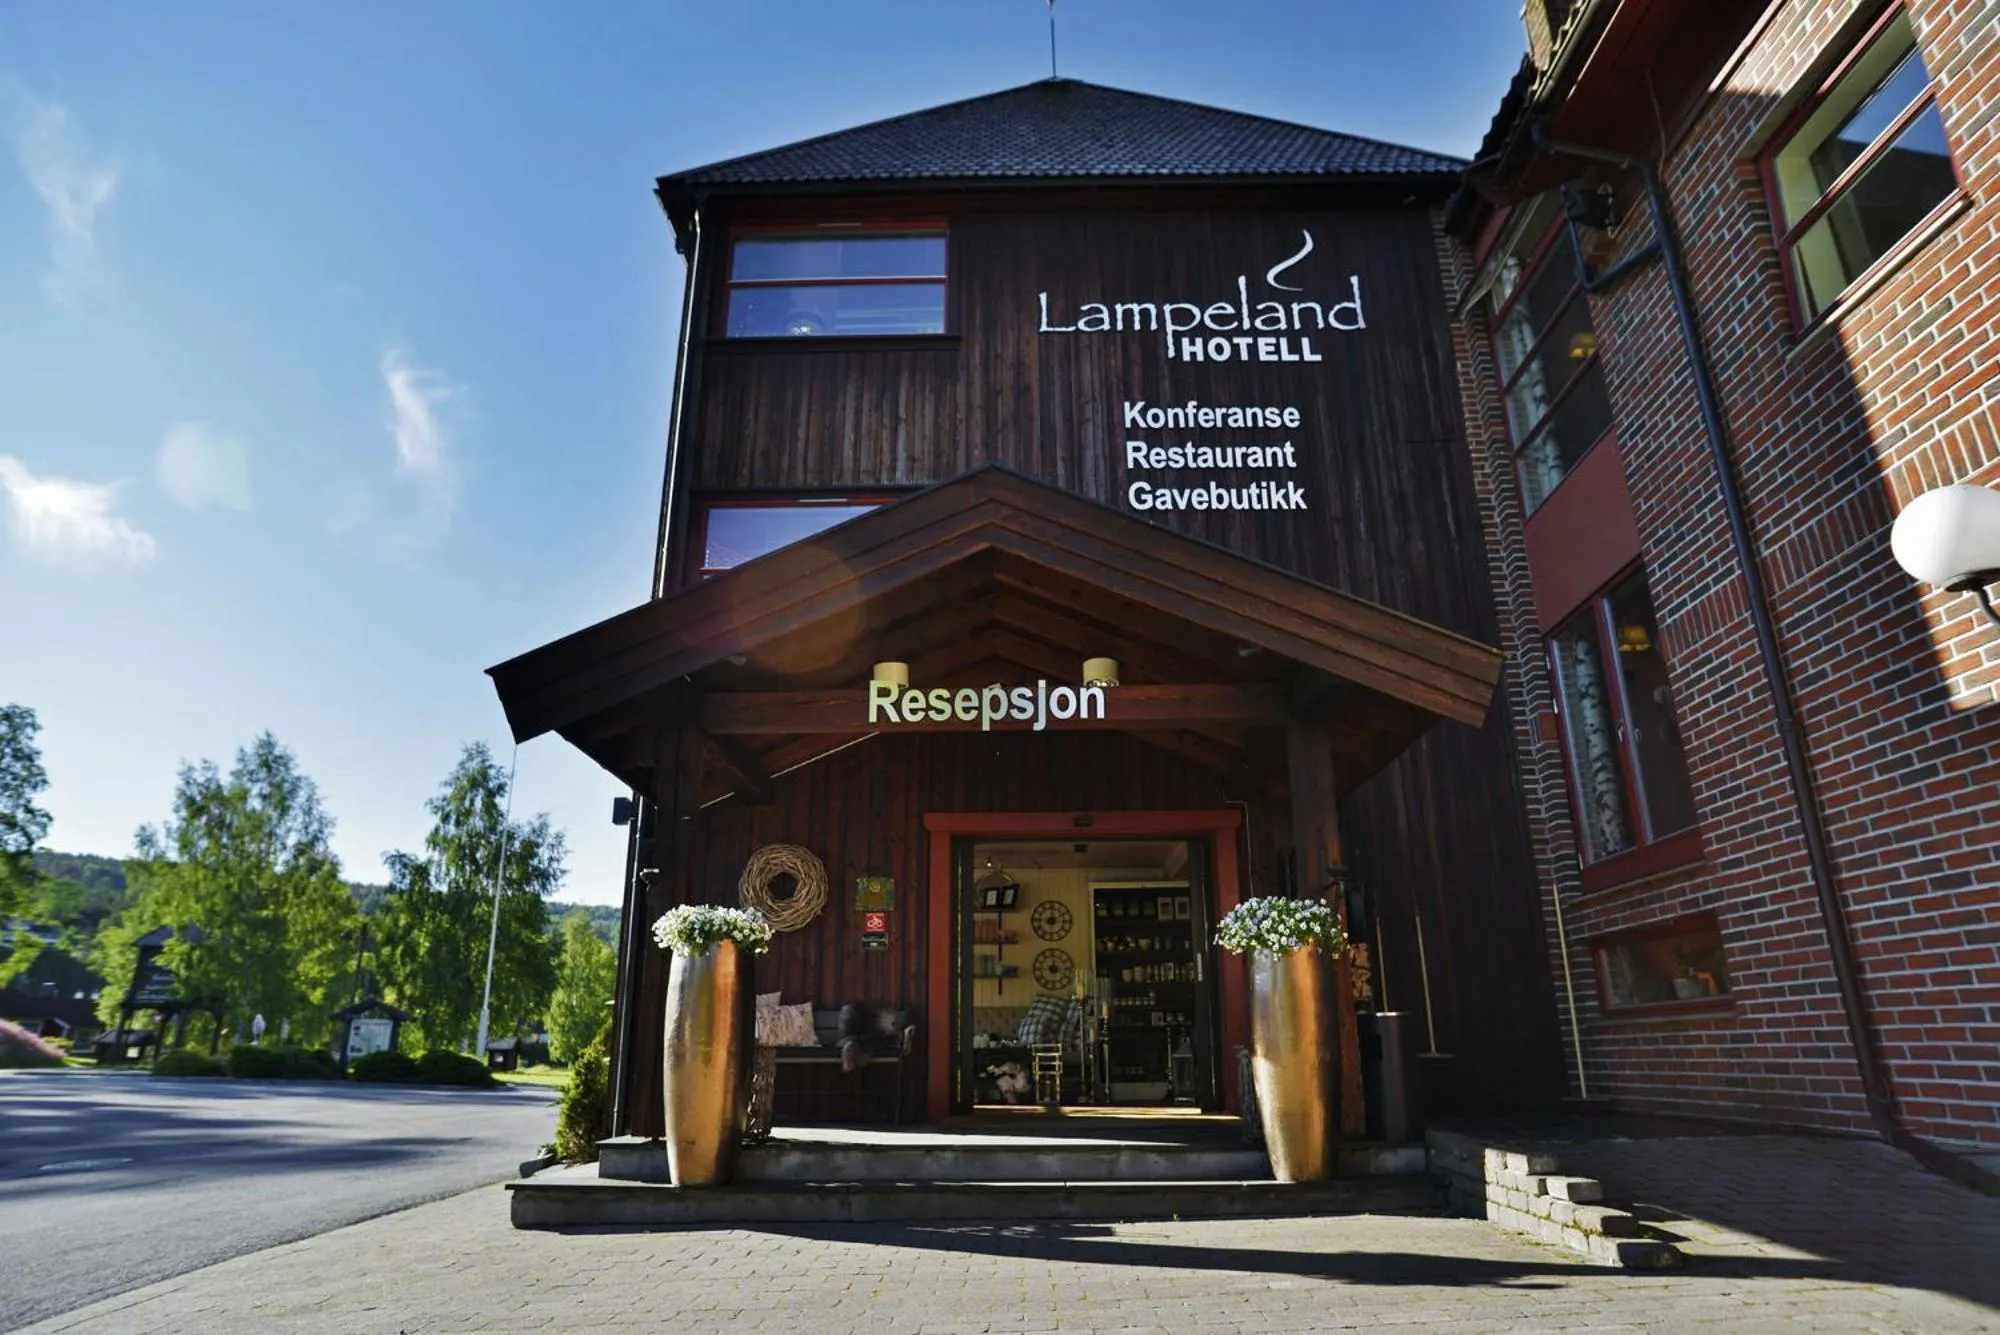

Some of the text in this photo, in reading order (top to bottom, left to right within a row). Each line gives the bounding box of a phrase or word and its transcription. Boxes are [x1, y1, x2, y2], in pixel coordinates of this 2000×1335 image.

[1038, 275, 1366, 358] Lampeland
[1181, 337, 1322, 362] HOTELL
[1123, 401, 1301, 428] Konferanse
[1126, 441, 1296, 469] Restaurant
[1128, 481, 1307, 510] Gavebutikk
[868, 679, 1105, 731] Resepsjon
